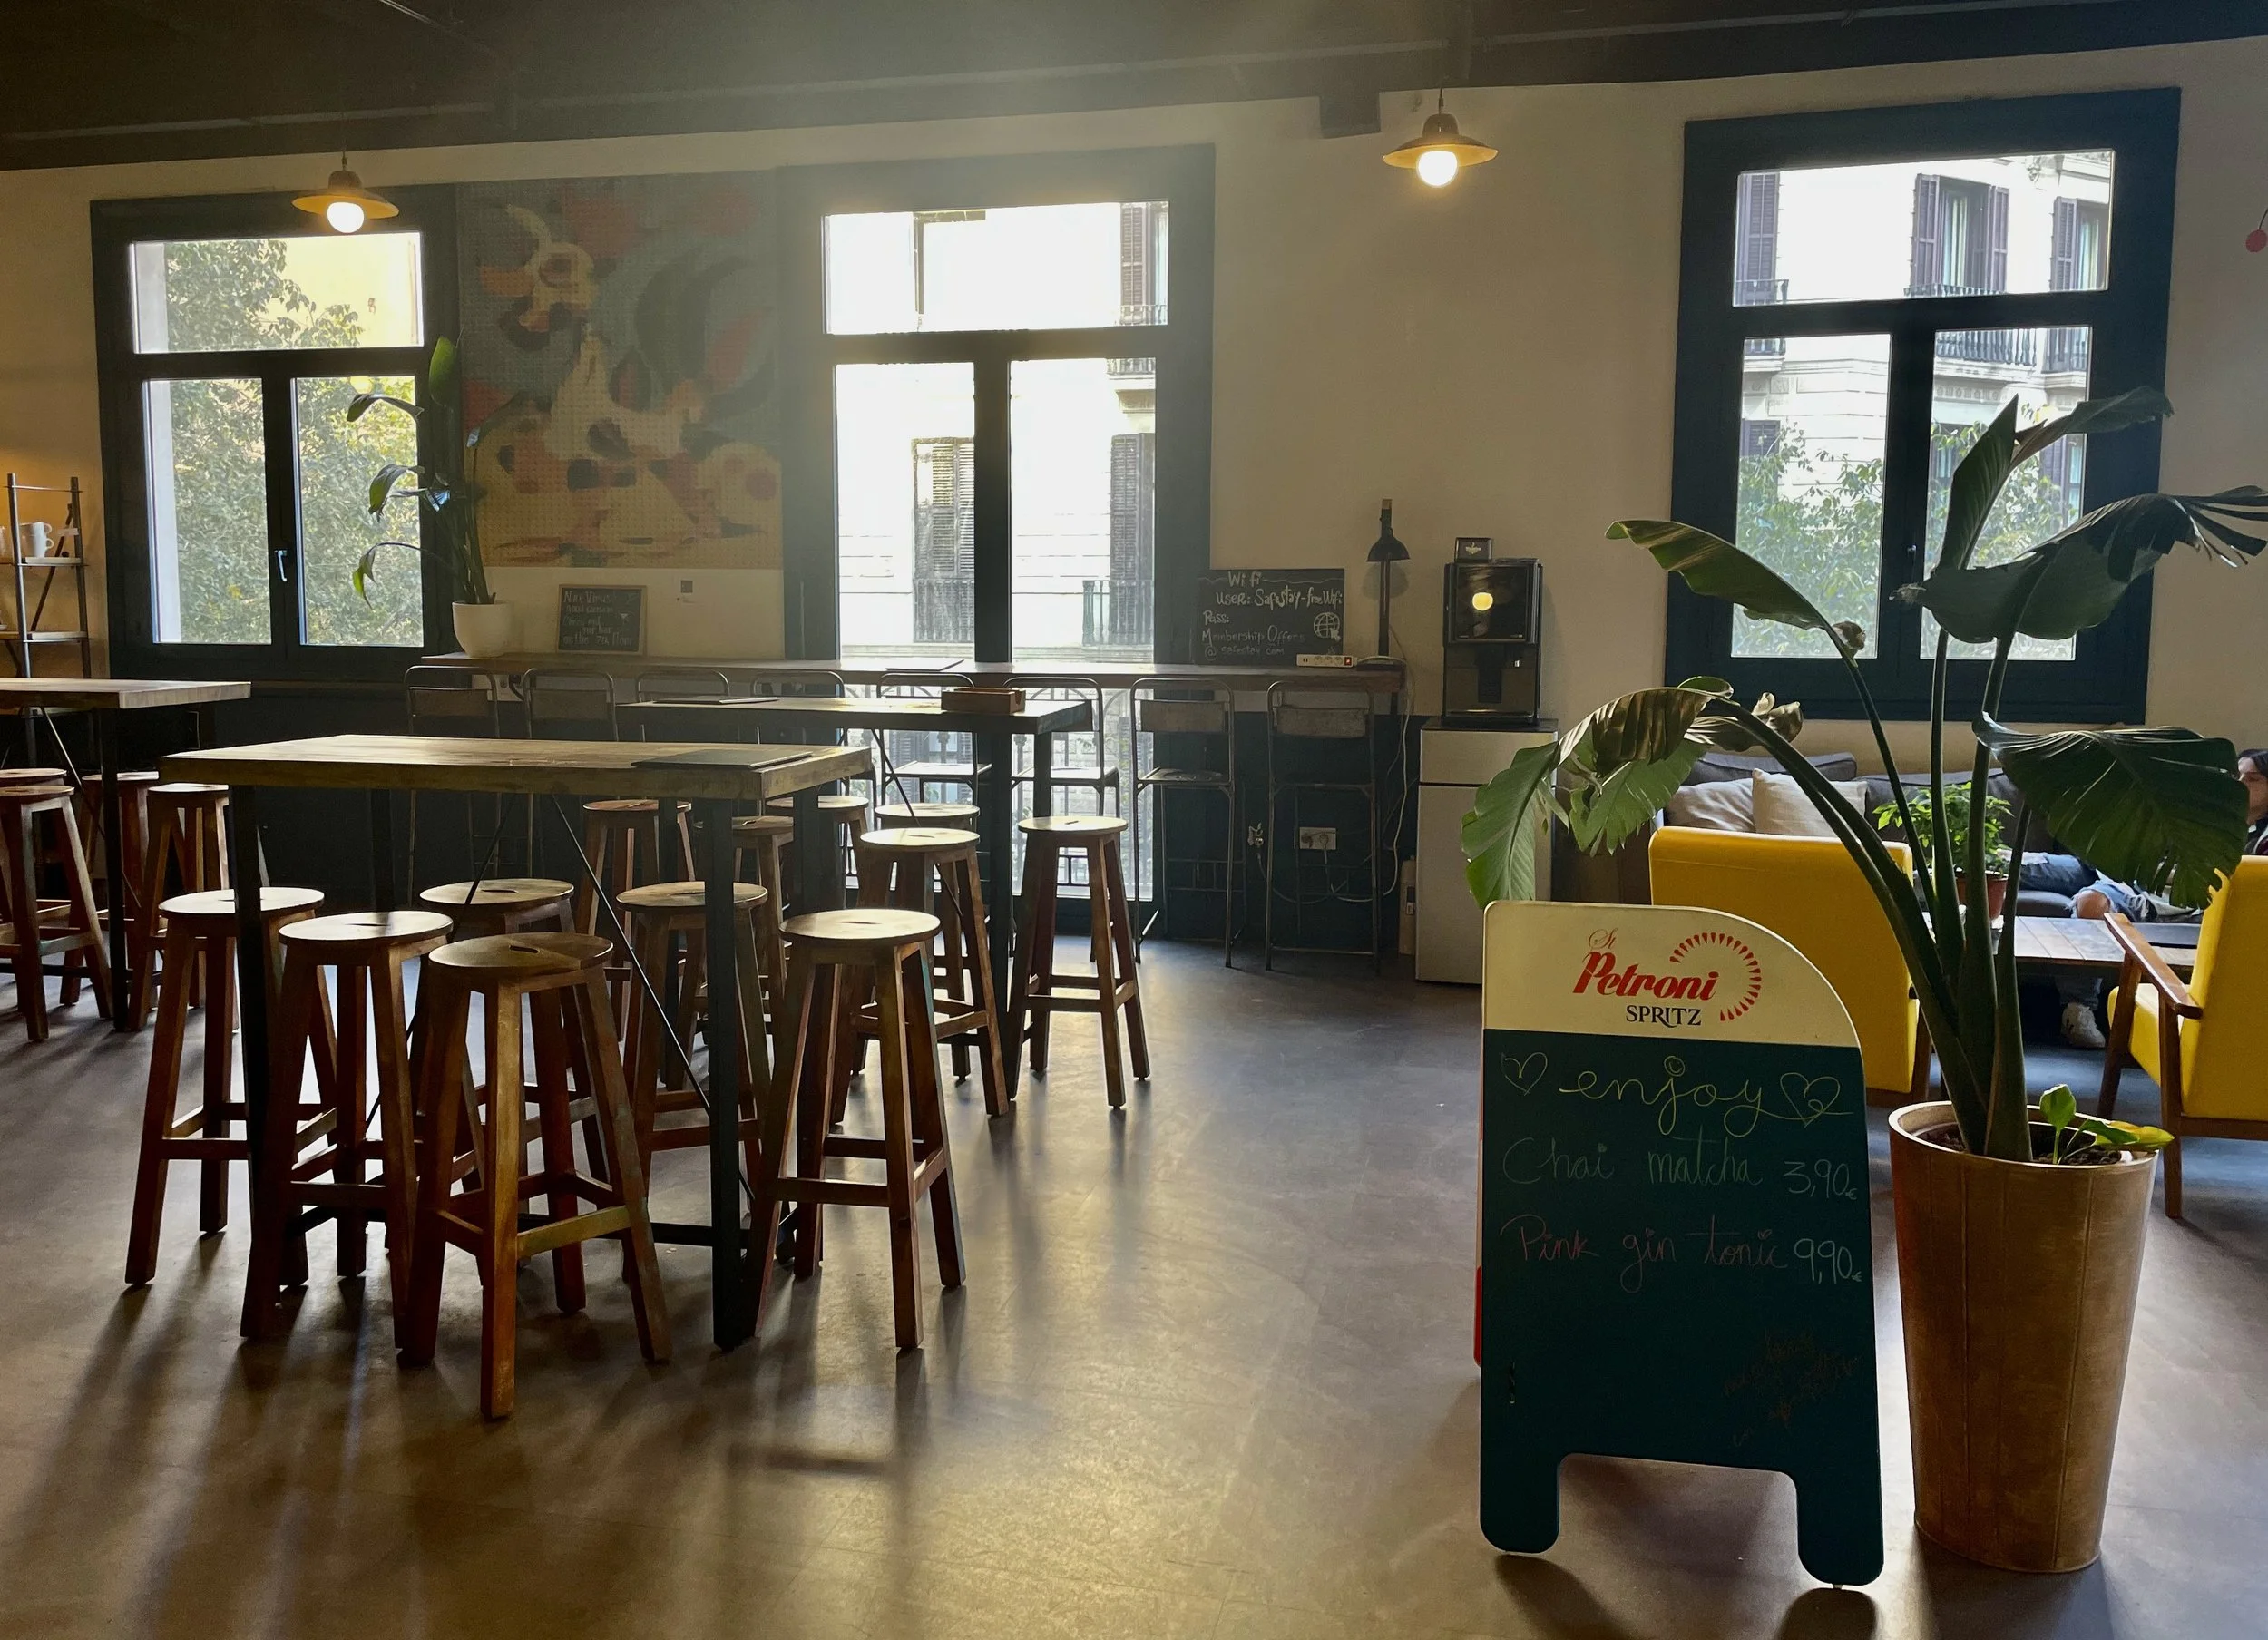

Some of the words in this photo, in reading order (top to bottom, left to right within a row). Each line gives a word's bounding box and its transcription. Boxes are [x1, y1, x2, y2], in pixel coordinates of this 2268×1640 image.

[1588, 928, 1617, 950] St
[1573, 951, 1719, 1001] Petroni
[1626, 1005, 1702, 1028] SPRITZ
[1559, 1056, 1763, 1137] enjoy
[1503, 1137, 1615, 1185] Chai
[1647, 1126, 1763, 1186] matcha
[1501, 1214, 1598, 1262] Pink
[1620, 1228, 1677, 1293] gin
[1685, 1215, 1787, 1269] tonic
